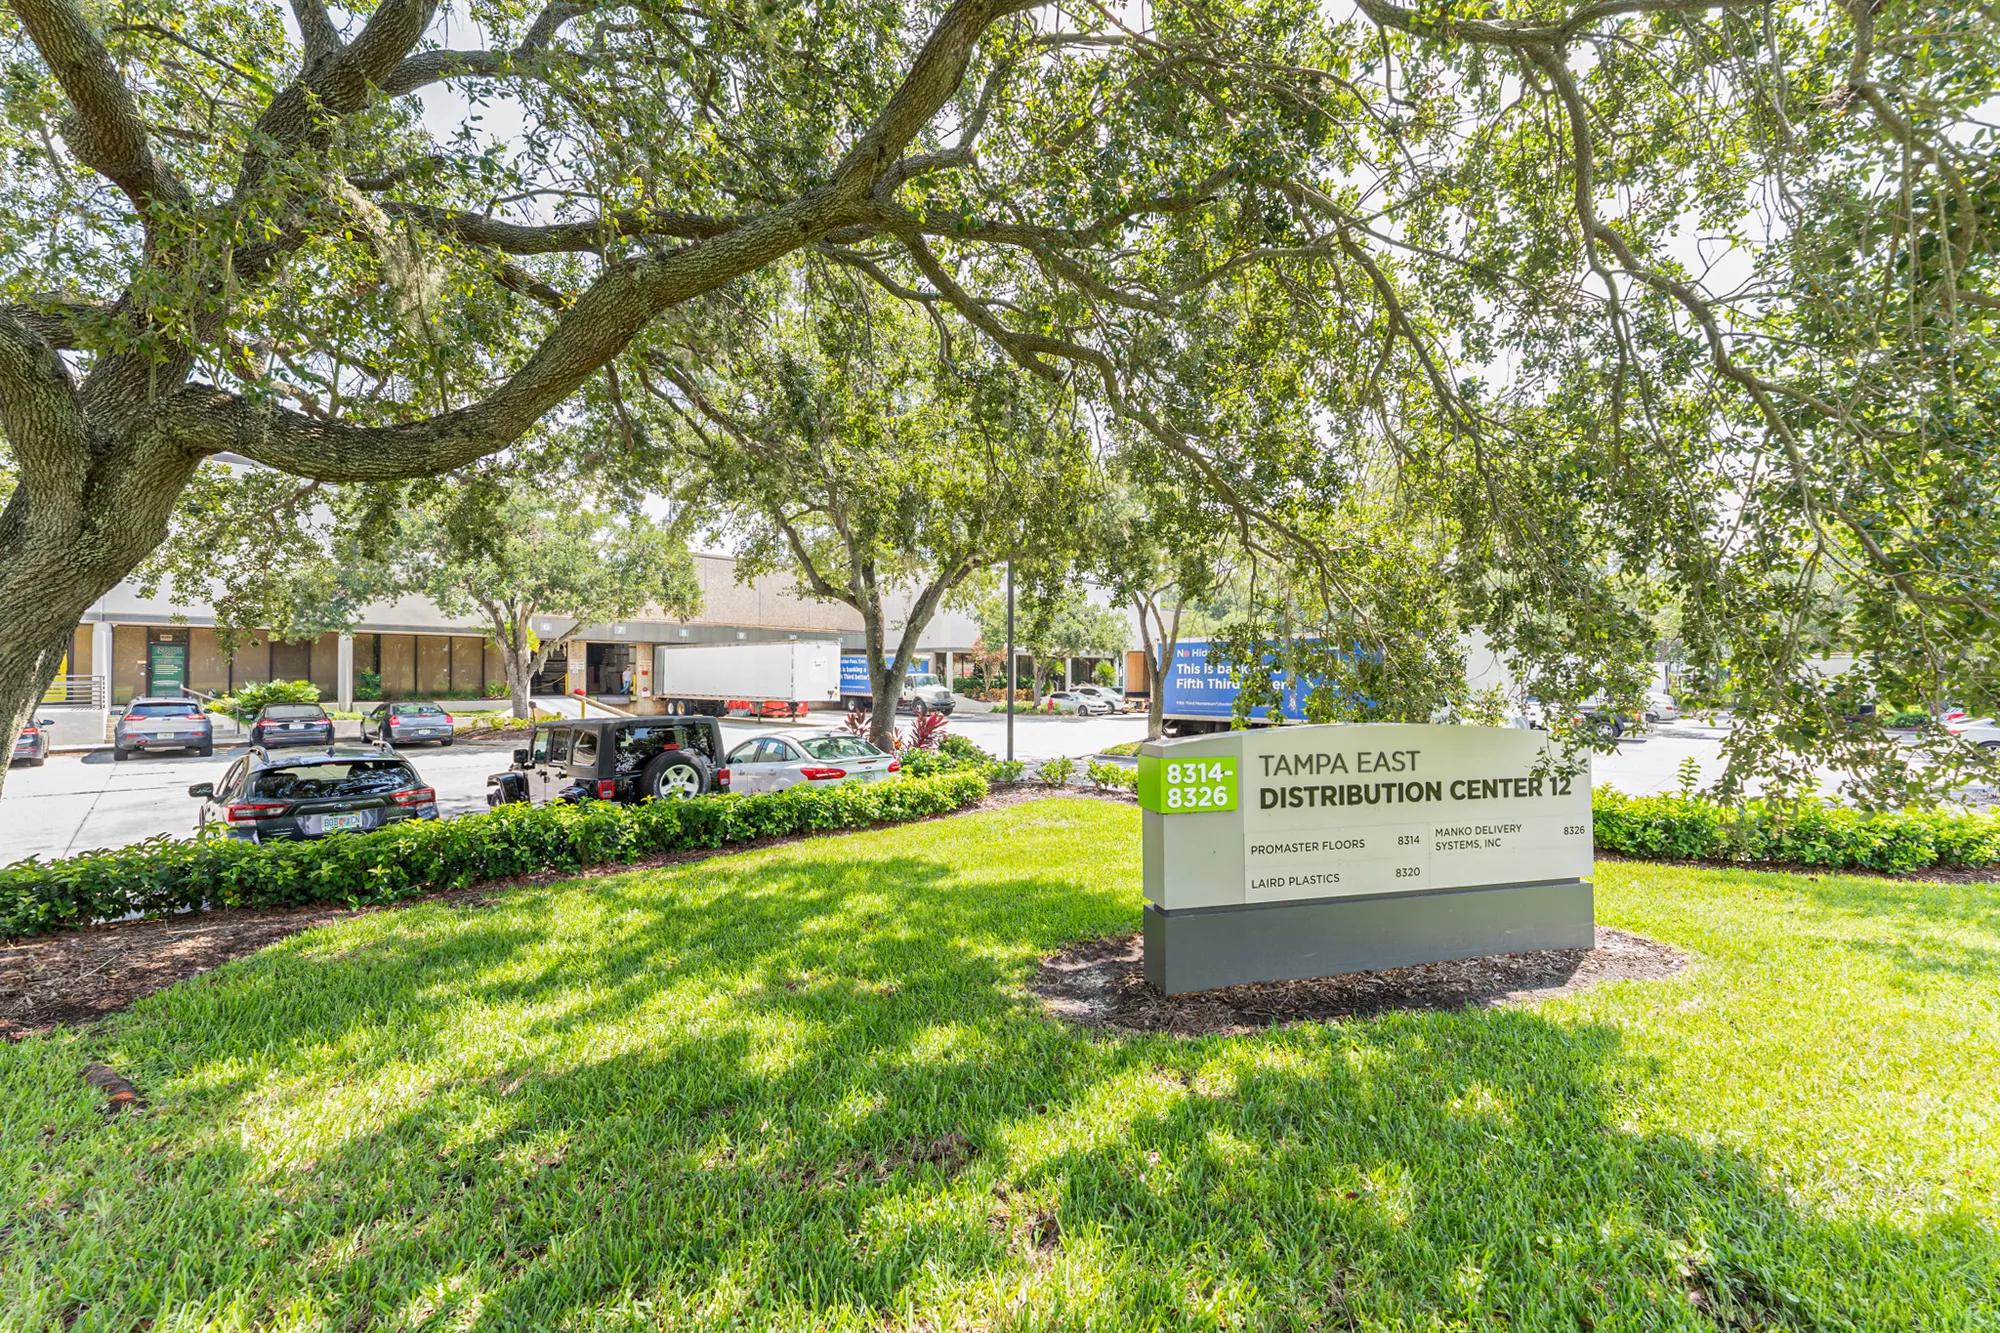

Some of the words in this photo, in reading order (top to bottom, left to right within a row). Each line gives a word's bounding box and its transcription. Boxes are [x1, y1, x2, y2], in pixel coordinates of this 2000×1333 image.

[1176, 663, 1201, 675] This
[1203, 662, 1214, 675] is
[1176, 678, 1204, 689] Fifth
[1258, 752, 1349, 777] TAMPA
[1357, 750, 1421, 773] EAST
[1167, 762, 1233, 784] 8314-
[1167, 786, 1228, 808] 8326
[1260, 781, 1442, 809] DISTRIBUTION
[1450, 777, 1543, 801] CENTER
[1549, 777, 1572, 796] 12
[1435, 826, 1473, 838] MANKO
[1475, 824, 1522, 836] DELIVERY
[1563, 825, 1586, 836] 8326
[1250, 842, 1319, 855] PROMASTER
[1322, 839, 1366, 851] FLOORS
[1397, 835, 1420, 846] 8314
[1435, 839, 1483, 851] SYSTEMS,
[1484, 838, 1502, 848] INC
[1395, 866, 1421, 878] 8320
[1251, 877, 1285, 889] LAIRD
[1288, 873, 1340, 887] PLASTICS
